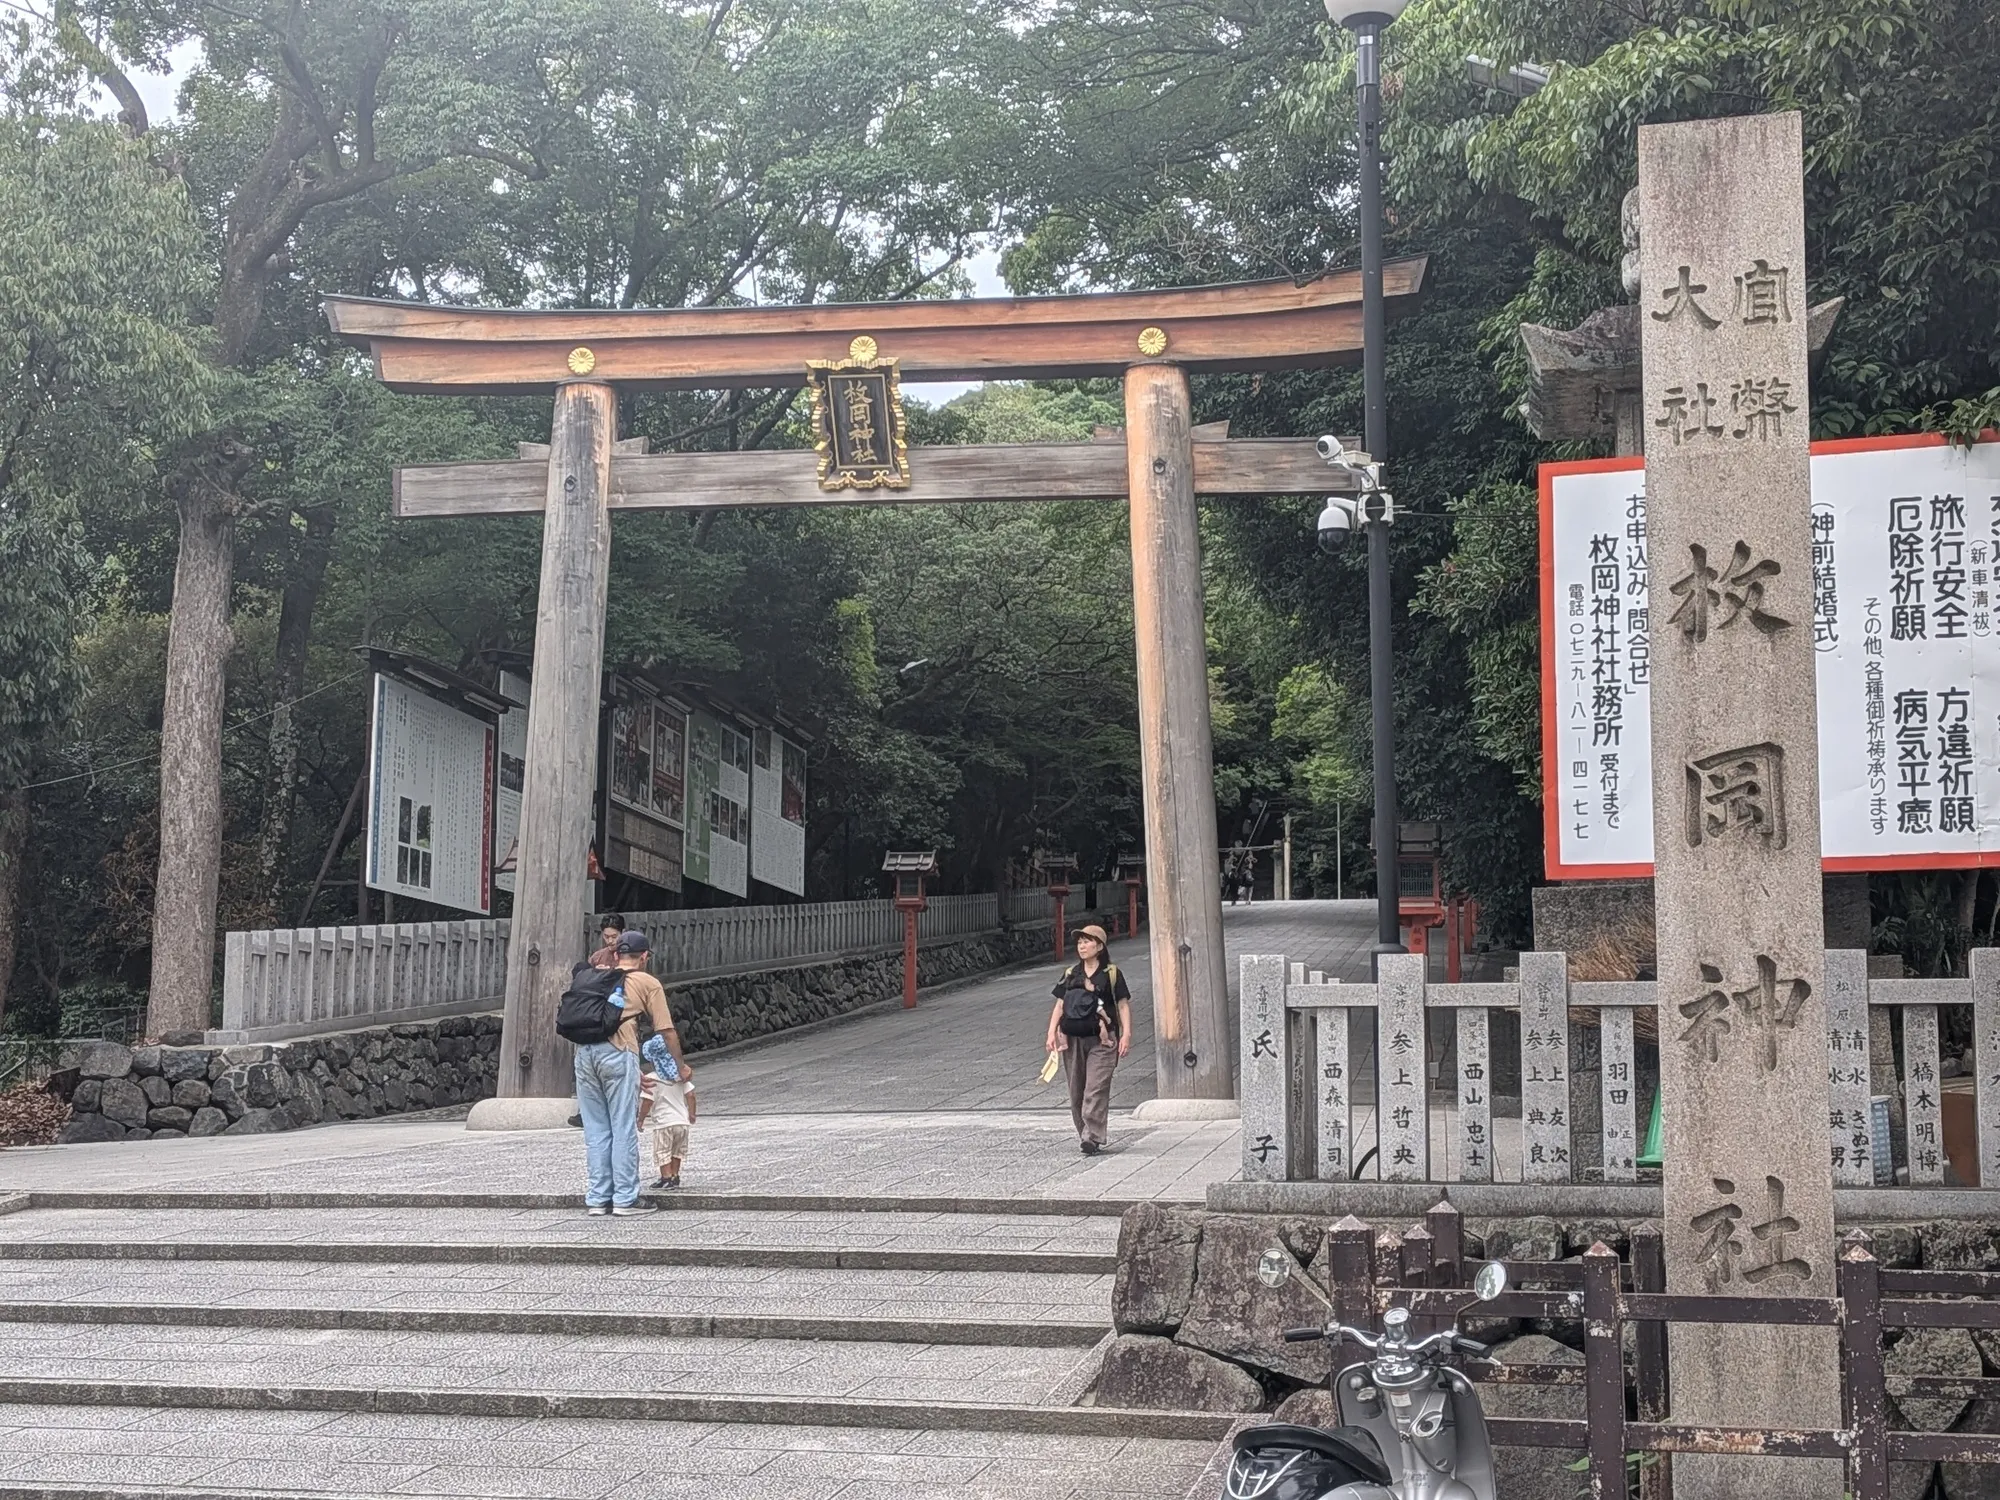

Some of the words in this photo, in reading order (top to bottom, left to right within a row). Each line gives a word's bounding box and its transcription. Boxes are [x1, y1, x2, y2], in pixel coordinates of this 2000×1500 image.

[843, 379, 878, 464] 枚岡神社
[1651, 265, 1724, 446] 大社
[1568, 583, 1585, 617] 電話
[1888, 496, 1928, 641] 厄除祈願
[1929, 494, 1969, 639] 旅行安全
[1588, 533, 1623, 747] 枚岡神社社務所
[1600, 753, 1620, 829] 受付まで
[1893, 688, 1933, 834] 病気平癒
[1936, 686, 1976, 833] 方違祈願
[1667, 539, 1812, 1284] 枚岡神社
[1323, 1062, 1345, 1166] 西森清司
[1389, 1029, 1416, 1165] 参上哲央
[1464, 1062, 1486, 1167] 西山忠士
[1524, 1028, 1548, 1164] 参上典良
[1546, 1028, 1569, 1163] 参上友次
[1607, 1061, 1629, 1106] 羽田
[1912, 1061, 1939, 1173] 橋本明博
